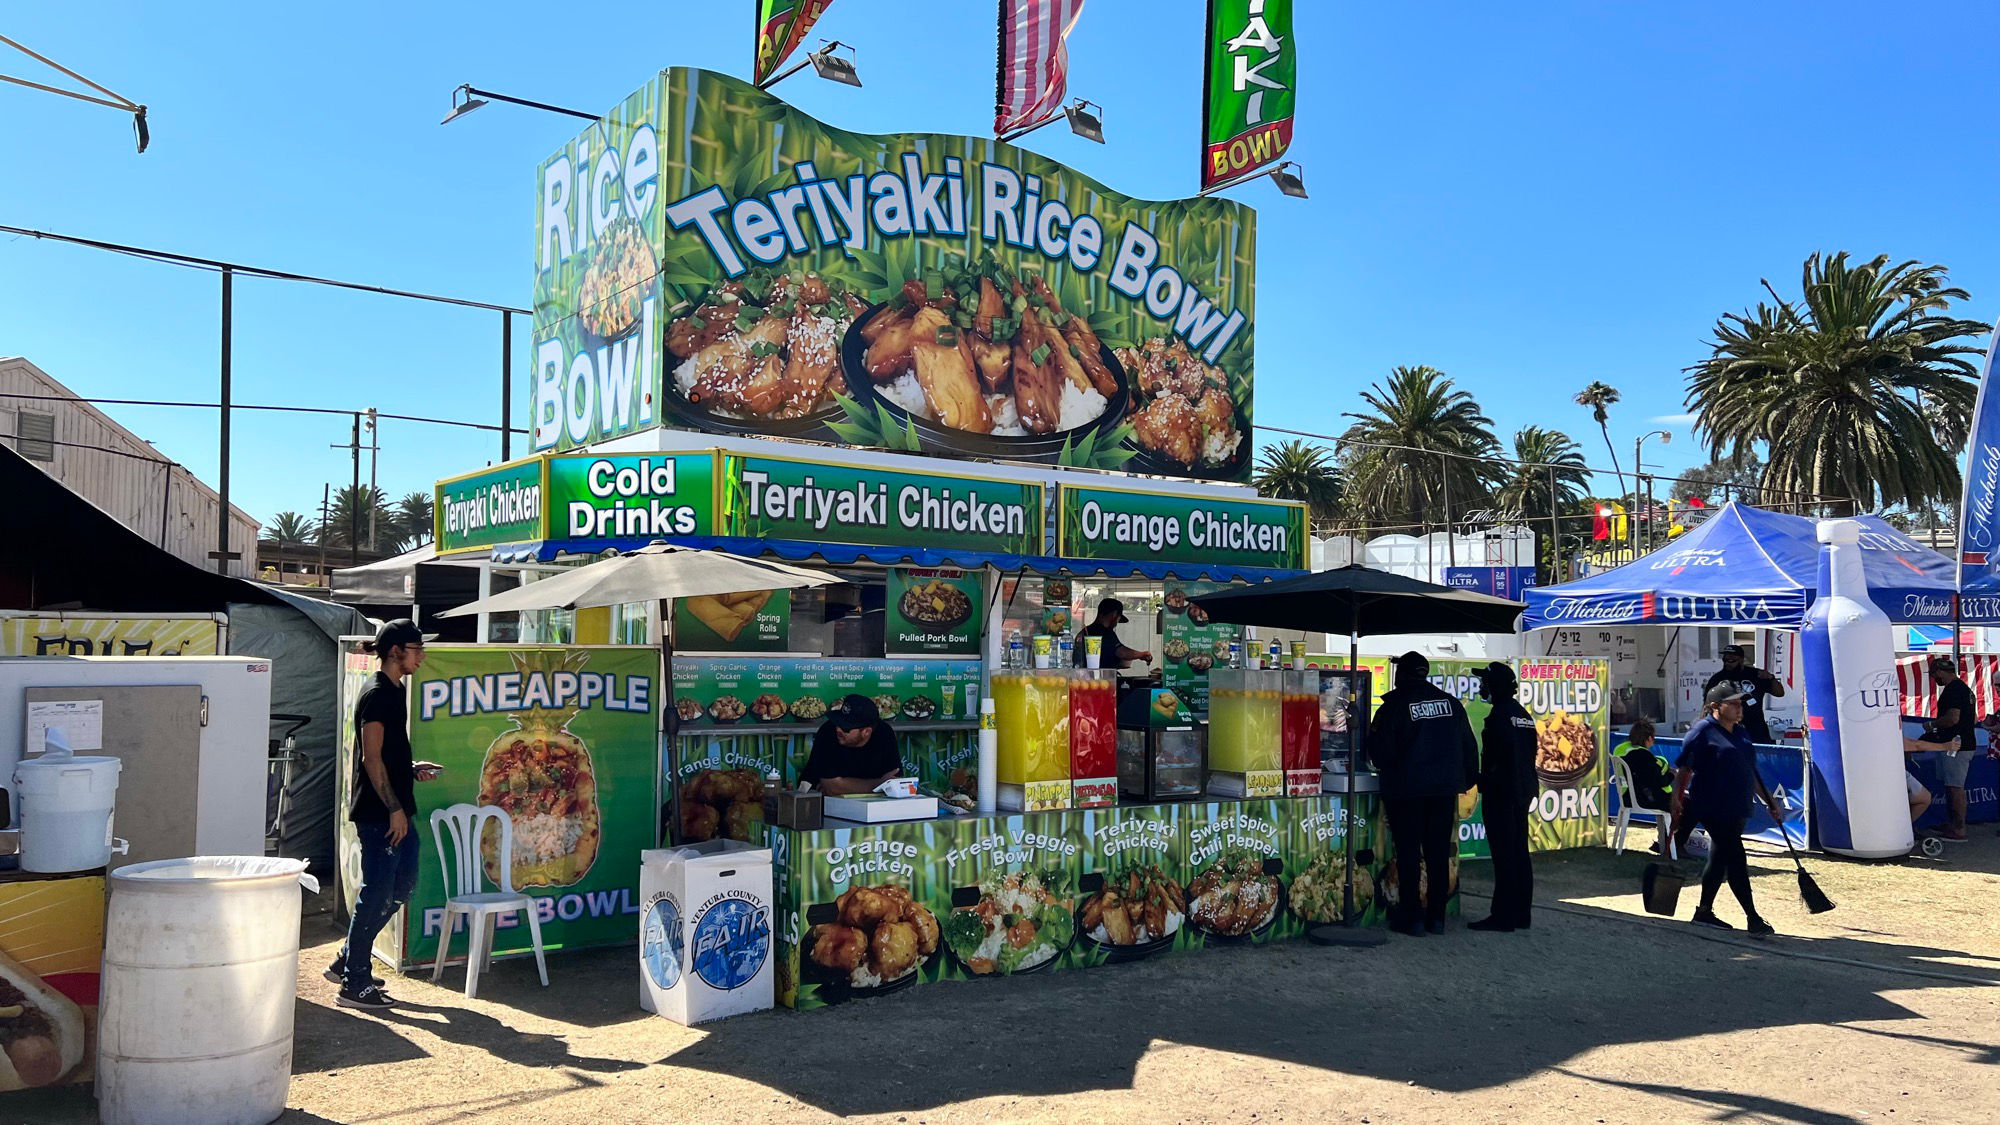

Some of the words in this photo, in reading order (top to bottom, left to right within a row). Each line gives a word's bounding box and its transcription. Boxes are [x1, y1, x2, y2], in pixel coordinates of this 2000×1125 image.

[1222, 0, 1291, 126] AKI
[1211, 130, 1289, 178] BOWL
[540, 122, 660, 272] Rice
[667, 152, 967, 278] Teriyaki
[980, 161, 1102, 271] Rice
[1108, 224, 1247, 365] Bowl
[534, 296, 659, 450] Bowl
[587, 458, 676, 497] Cold
[443, 482, 488, 537] Teriyaki
[489, 478, 540, 526] Chicken
[741, 470, 888, 531] Teriyaki
[897, 485, 1025, 536] Chicken
[567, 500, 697, 537] Drinks
[1081, 500, 1180, 552] Orange
[1187, 509, 1288, 553] Chicken
[1856, 532, 1921, 552] LTRA
[1650, 556, 1727, 570] ULTRA
[1448, 578, 1479, 586] ULTRA
[1544, 597, 1636, 621] Michelob
[1662, 597, 1777, 621] ULTRA
[1903, 594, 1950, 618] Michelob
[1962, 598, 2000, 618] ULTR
[756, 612, 781, 625] Spring
[759, 623, 777, 633] Rolls
[899, 633, 926, 642] Pulled
[927, 634, 947, 642] Pork
[948, 634, 968, 643] Bowl
[1559, 631, 1568, 642] $9
[1570, 631, 1581, 642] $12
[1600, 632, 1611, 643] $10
[1616, 636, 1623, 646] $7
[1616, 652, 1623, 662] $3
[1775, 633, 1783, 680] LTRA
[672, 663, 699, 671] Teriyaki
[672, 672, 699, 680] Chicken
[709, 663, 727, 671] Spicy
[728, 663, 747, 671] Garlic
[715, 672, 741, 680] Chicken
[757, 672, 782, 680] Chicken
[758, 663, 781, 671] Orange
[795, 663, 811, 671] Fried
[812, 663, 825, 671] Rice
[802, 672, 817, 680] Bowl
[829, 672, 843, 680] Chili
[844, 673, 865, 682] Pepper
[848, 664, 865, 672] Spicy
[885, 665, 905, 673] Veggie
[935, 673, 963, 681] Lemonade
[963, 673, 980, 681] Drinks
[1520, 664, 1563, 679] SWEET
[1564, 664, 1597, 679] CHILI
[420, 671, 651, 721] PINEAPPLE
[1520, 680, 1602, 715] PULLED
[1860, 689, 1900, 708] ULT
[1411, 700, 1450, 720] SECURITY
[937, 746, 972, 771] Fresh
[1025, 782, 1071, 802] PINEAPPLE
[1094, 817, 1177, 843] Teriyaki
[1189, 816, 1236, 844] Sweet
[1238, 814, 1278, 839] Spicy
[1300, 810, 1335, 833] Fried
[1339, 808, 1367, 828] Rce
[1315, 826, 1348, 842] Bow
[826, 839, 918, 865] Orange
[945, 832, 1005, 868] Fresh
[1010, 829, 1076, 856] Veggie
[1103, 833, 1169, 857] Chicken
[1189, 836, 1223, 866] Chili
[1226, 834, 1280, 859] Pepper
[993, 848, 1035, 867] Bowl
[830, 855, 914, 884] Chicken
[643, 890, 666, 913] VENTURA
[666, 890, 683, 914] COUNTY
[690, 892, 725, 925] VENTURA
[726, 889, 763, 906] COUNTY
[423, 905, 520, 938] RIE
[535, 888, 640, 924] BOWL
[642, 916, 685, 959] FAIR
[689, 905, 771, 974] FAIR
